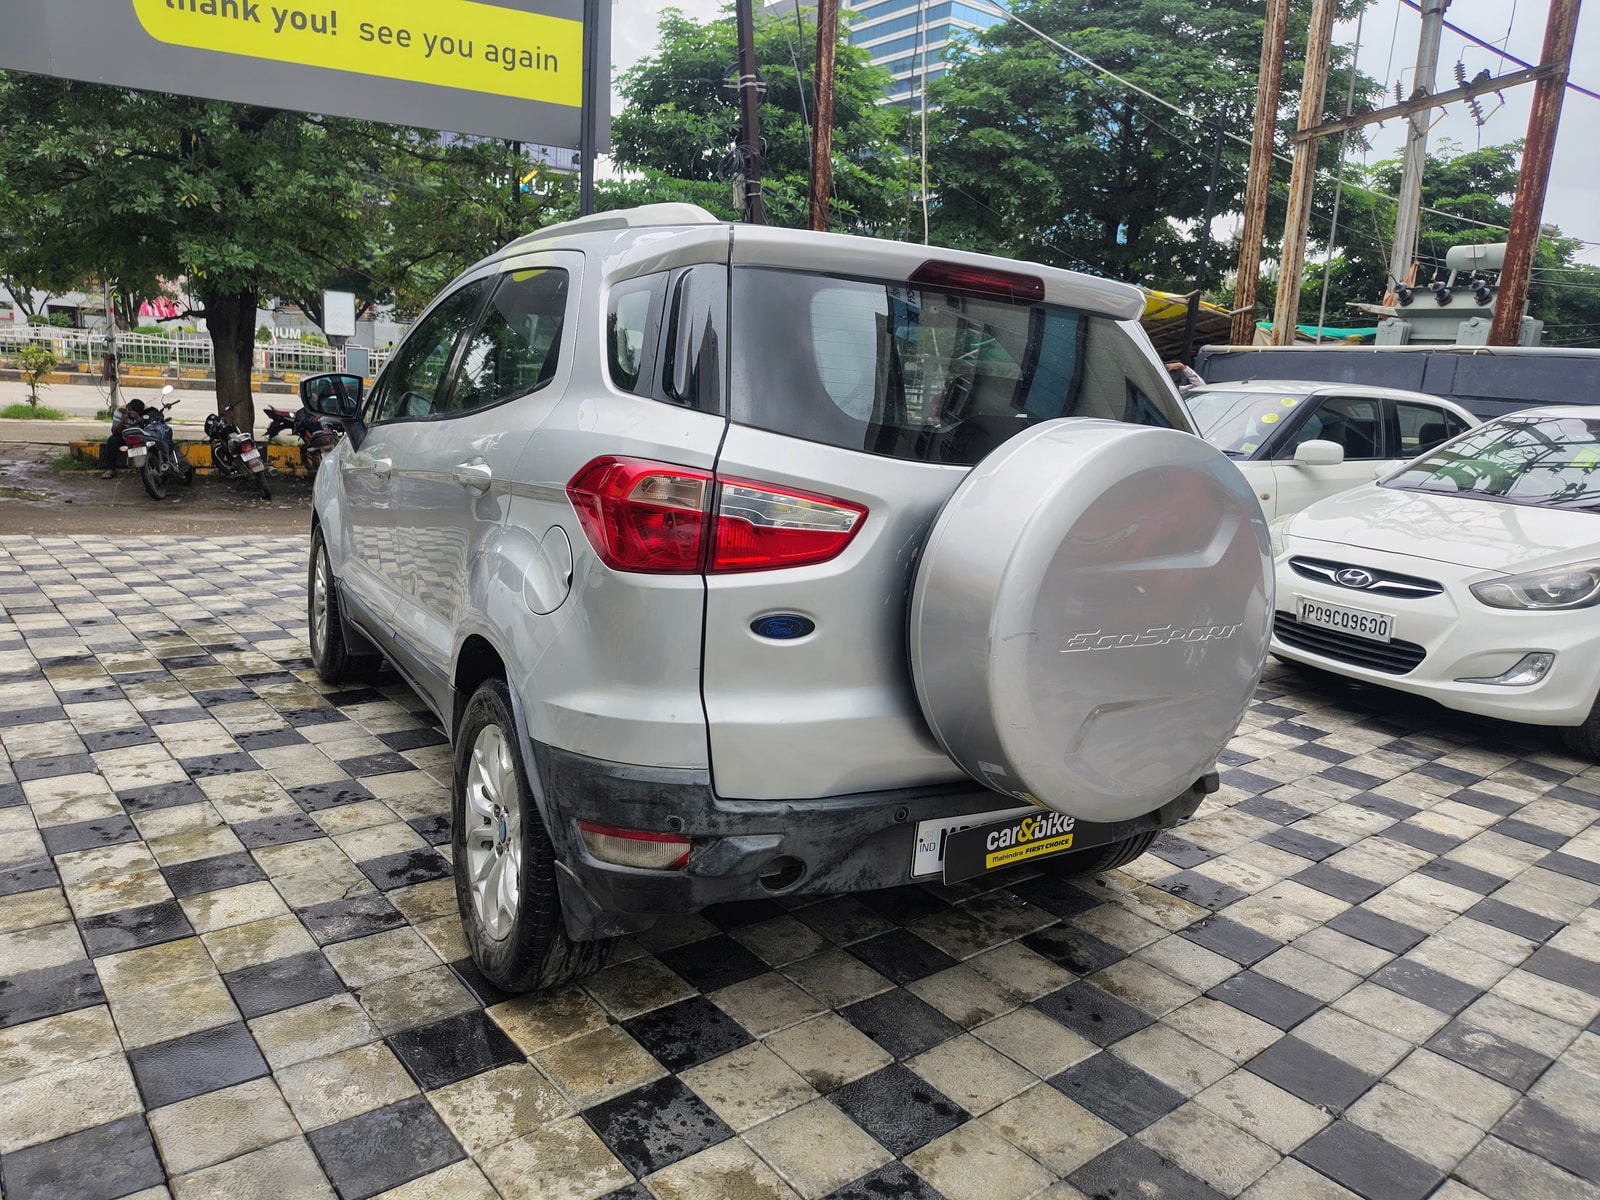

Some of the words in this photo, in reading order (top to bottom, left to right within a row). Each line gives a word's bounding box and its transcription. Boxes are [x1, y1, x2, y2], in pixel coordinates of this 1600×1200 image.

[271, 6, 337, 36] you!
[359, 21, 412, 48] see
[423, 32, 473, 59] you
[484, 45, 559, 73] again
[919, 842, 936, 853] IND
[986, 812, 1075, 851] car&bike
[992, 850, 1024, 863] Mahindra
[1025, 844, 1046, 855] FIRST
[1045, 838, 1070, 849] CHOICE
